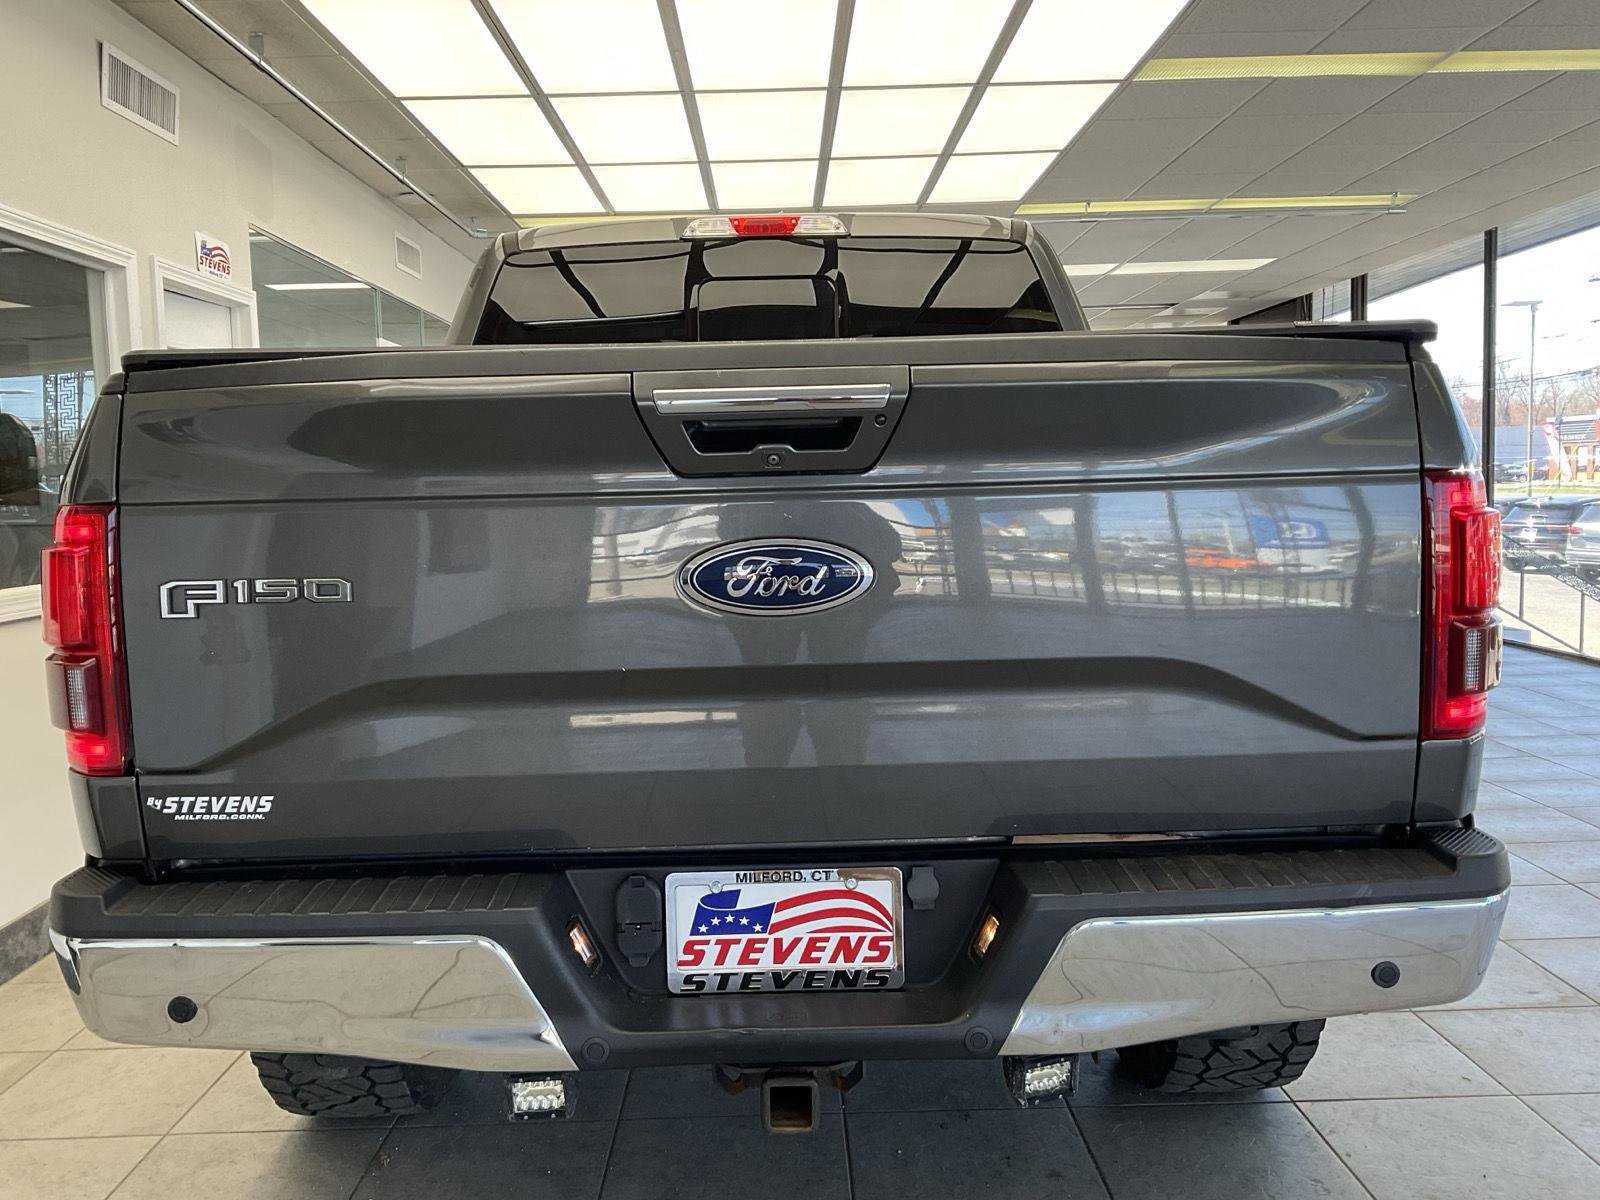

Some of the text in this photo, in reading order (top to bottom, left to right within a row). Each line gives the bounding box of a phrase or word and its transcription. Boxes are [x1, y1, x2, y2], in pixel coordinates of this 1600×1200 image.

[200, 256, 230, 275] STEVENS
[726, 556, 827, 598] Ford
[146, 796, 274, 813] By STEVENS
[735, 870, 834, 883] MILFORD, CT
[677, 936, 894, 967] STEVENS
[680, 970, 891, 992] STEVENS
